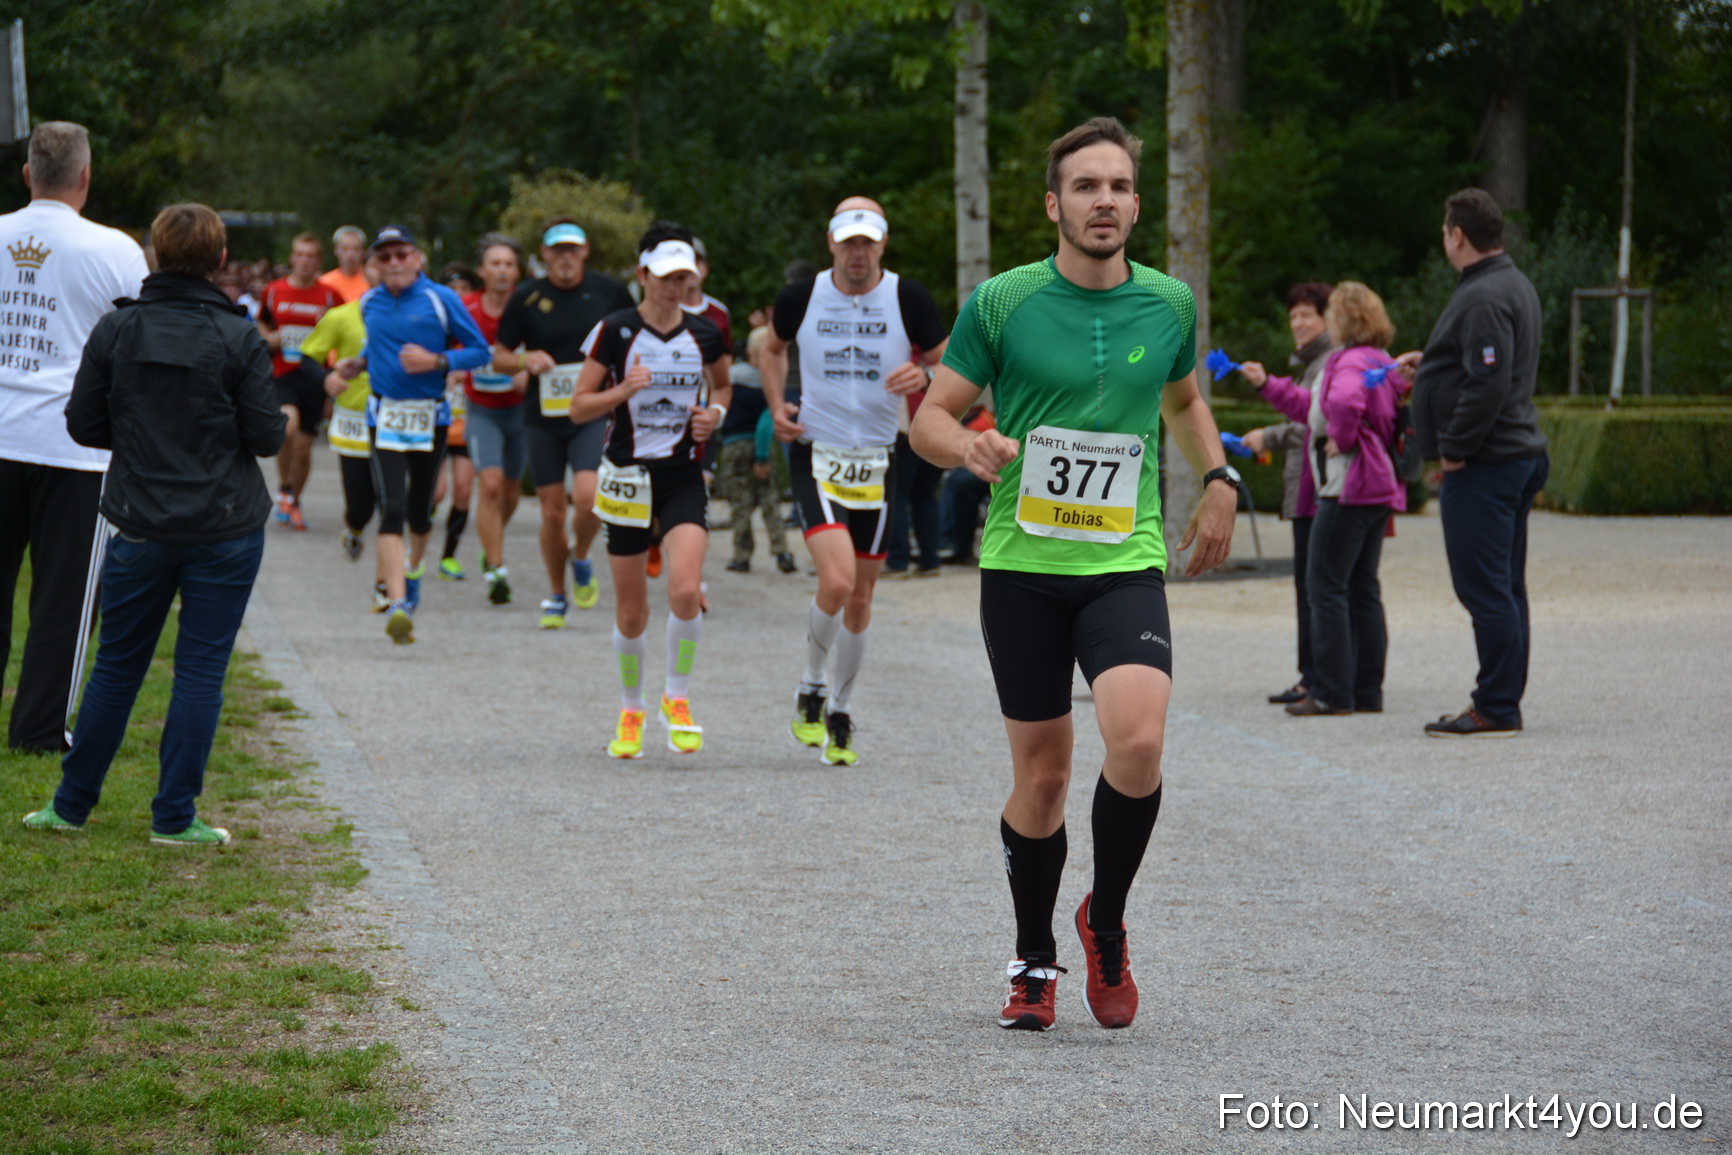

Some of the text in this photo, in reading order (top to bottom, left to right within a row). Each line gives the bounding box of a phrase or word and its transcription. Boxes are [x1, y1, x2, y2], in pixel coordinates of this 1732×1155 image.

[18, 270, 35, 285] IM
[0, 290, 57, 312] UFTRAG
[1, 311, 47, 332] SEINER
[0, 333, 59, 357] AJESTÄT:
[1, 353, 41, 373] JESUS
[550, 377, 574, 396] 50
[383, 410, 431, 432] 2379
[1029, 435, 1126, 456] PARTL Neumarkt
[828, 461, 873, 483] 246
[1046, 455, 1121, 500] 377
[1053, 506, 1104, 527] Tobias
